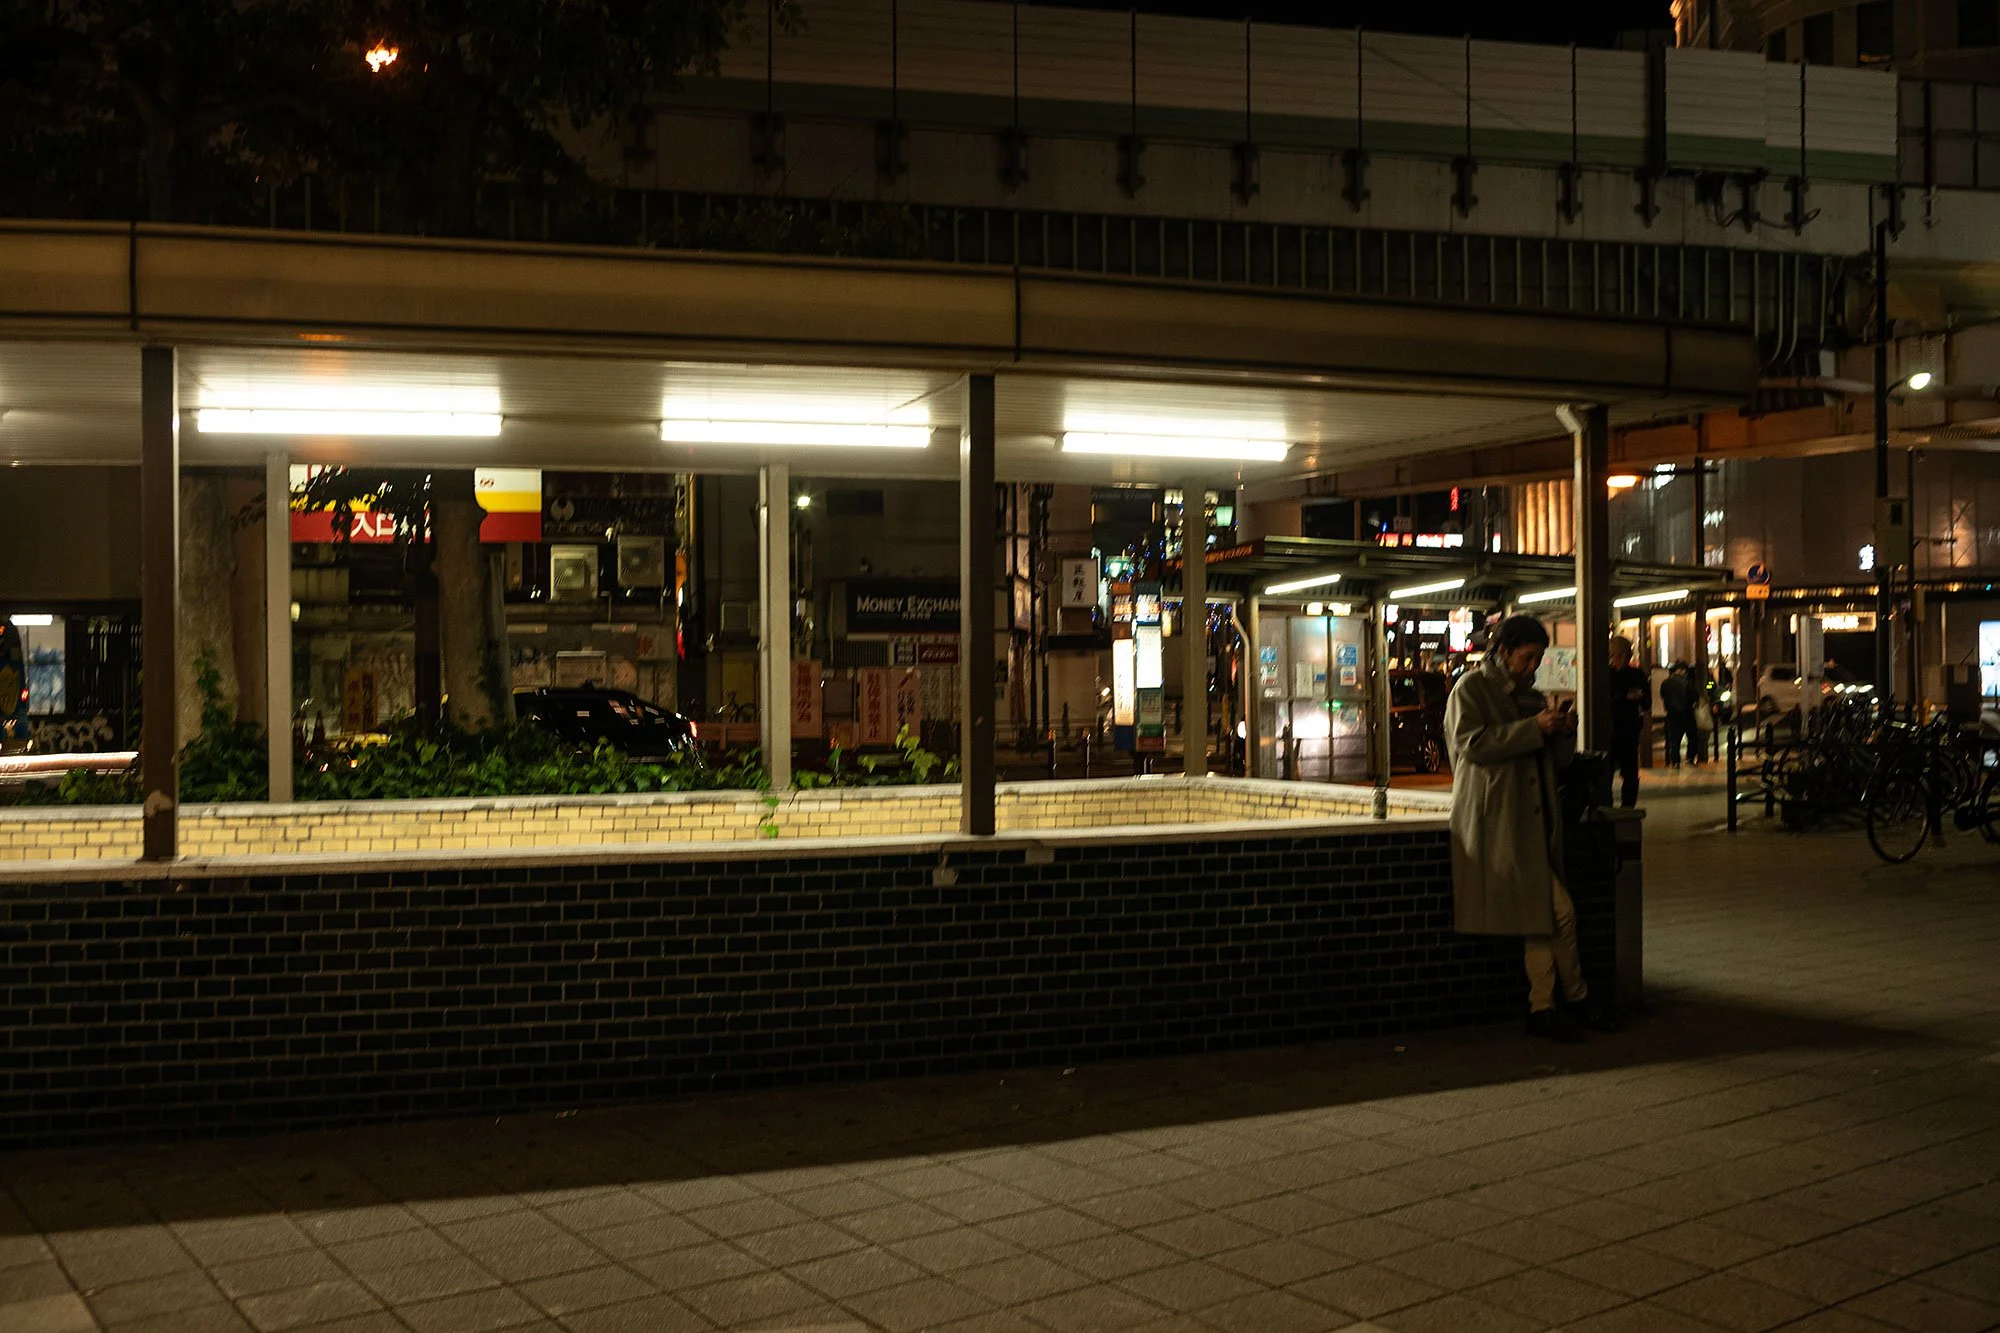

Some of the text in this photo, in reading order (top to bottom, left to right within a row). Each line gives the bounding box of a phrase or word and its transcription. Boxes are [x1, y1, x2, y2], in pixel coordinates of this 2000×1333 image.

[350, 512, 397, 538] 入口
[857, 595, 961, 613] MONEY EXCHAN
